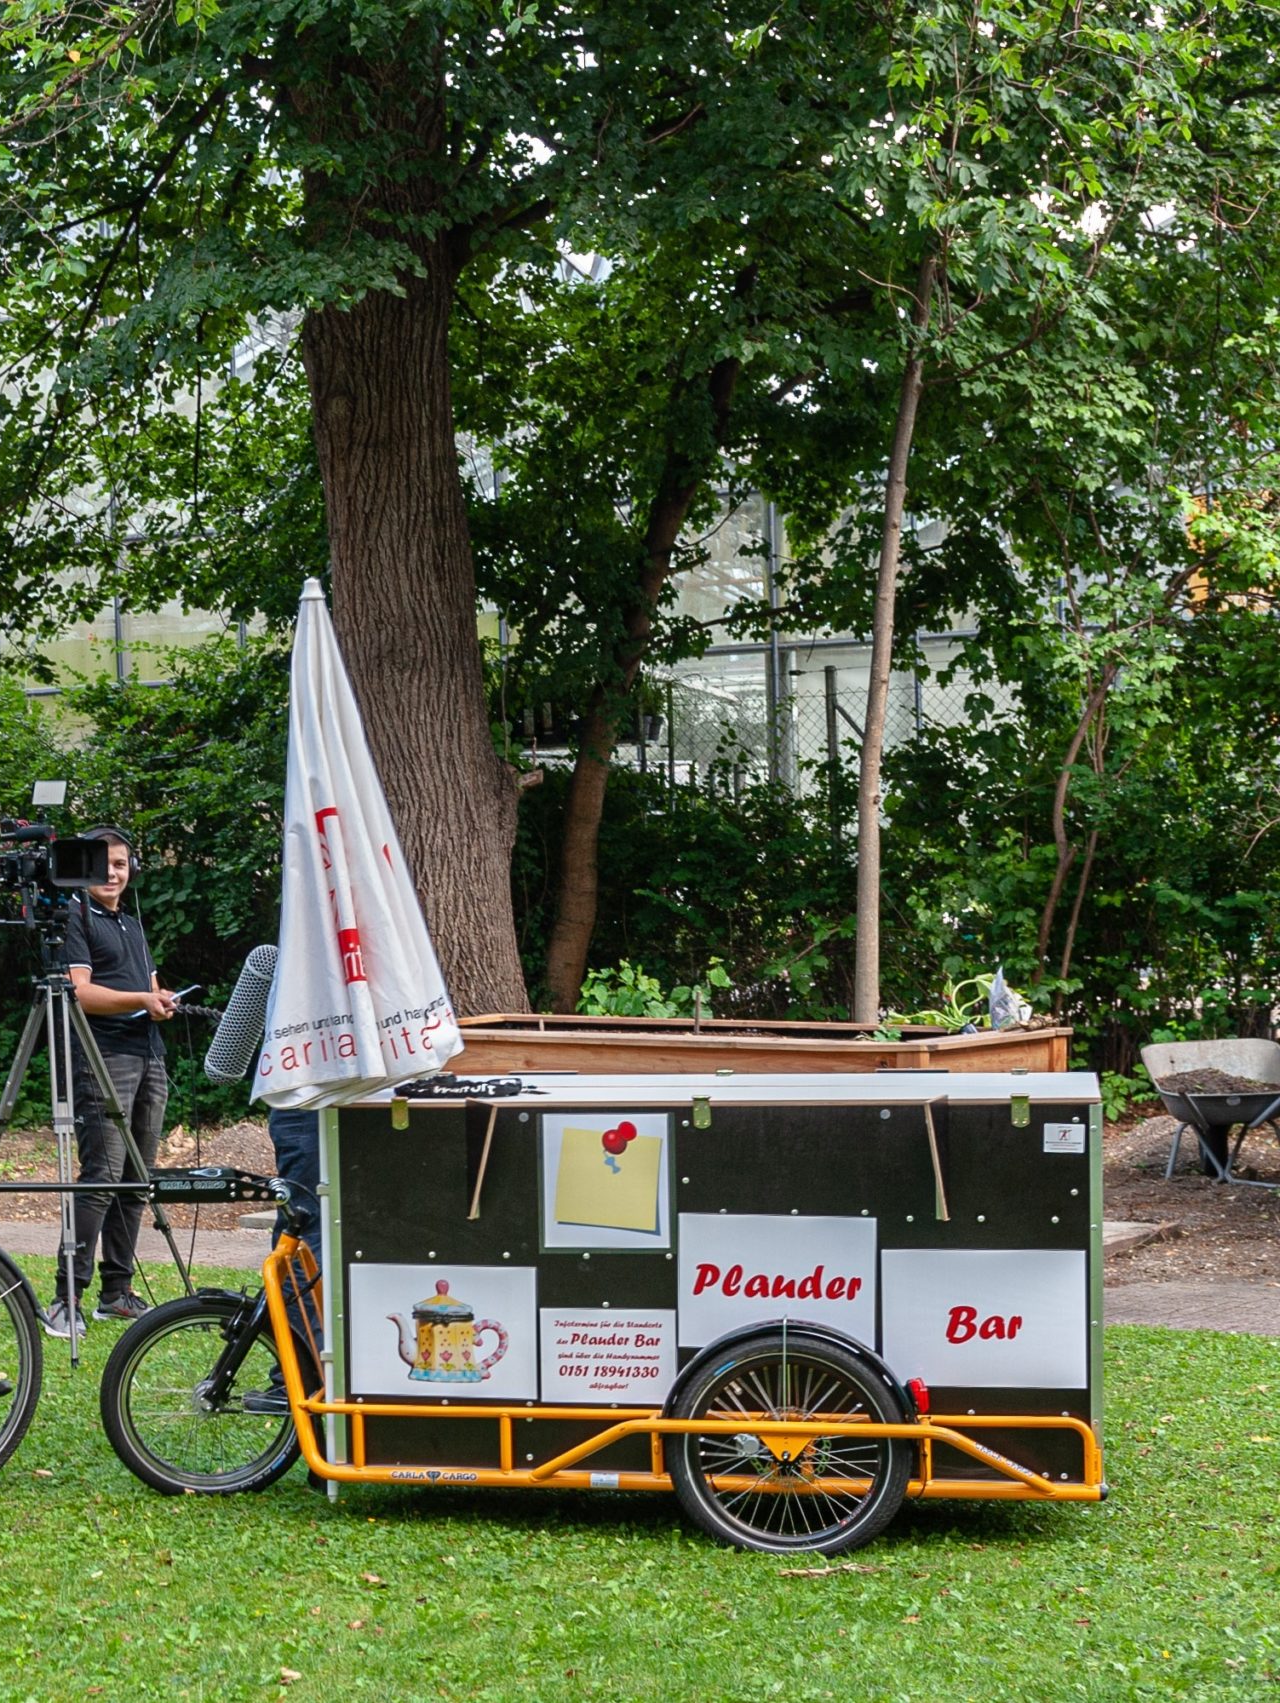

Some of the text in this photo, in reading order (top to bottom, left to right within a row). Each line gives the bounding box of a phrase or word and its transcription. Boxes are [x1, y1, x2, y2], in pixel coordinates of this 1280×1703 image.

[693, 1263, 861, 1300] Plauder
[600, 1320, 611, 1329] für
[945, 1305, 1022, 1344] Bar
[570, 1333, 629, 1346] Plauder
[634, 1334, 661, 1347] Bar
[606, 1353, 660, 1361] Handynummer
[559, 1365, 659, 1378] 0151 18941330
[391, 1471, 477, 1481] CARLA CARGO
